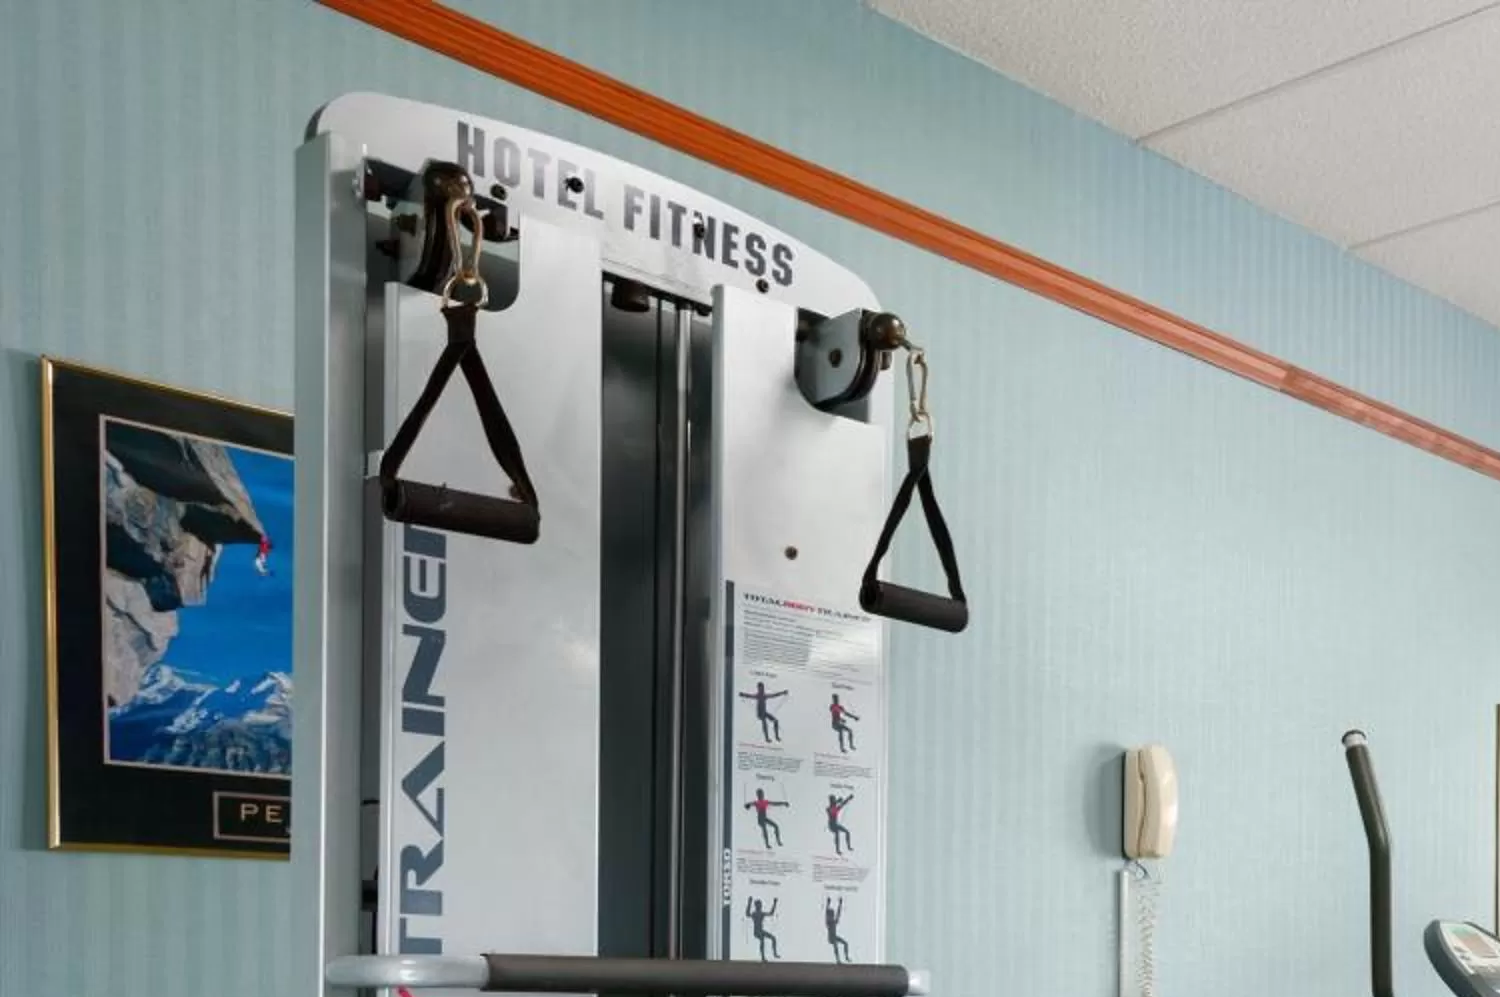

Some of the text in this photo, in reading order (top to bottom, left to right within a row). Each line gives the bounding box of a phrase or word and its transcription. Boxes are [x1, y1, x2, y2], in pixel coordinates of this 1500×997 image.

[457, 120, 793, 287] HOTEL FITNESS
[241, 803, 283, 823] PE
